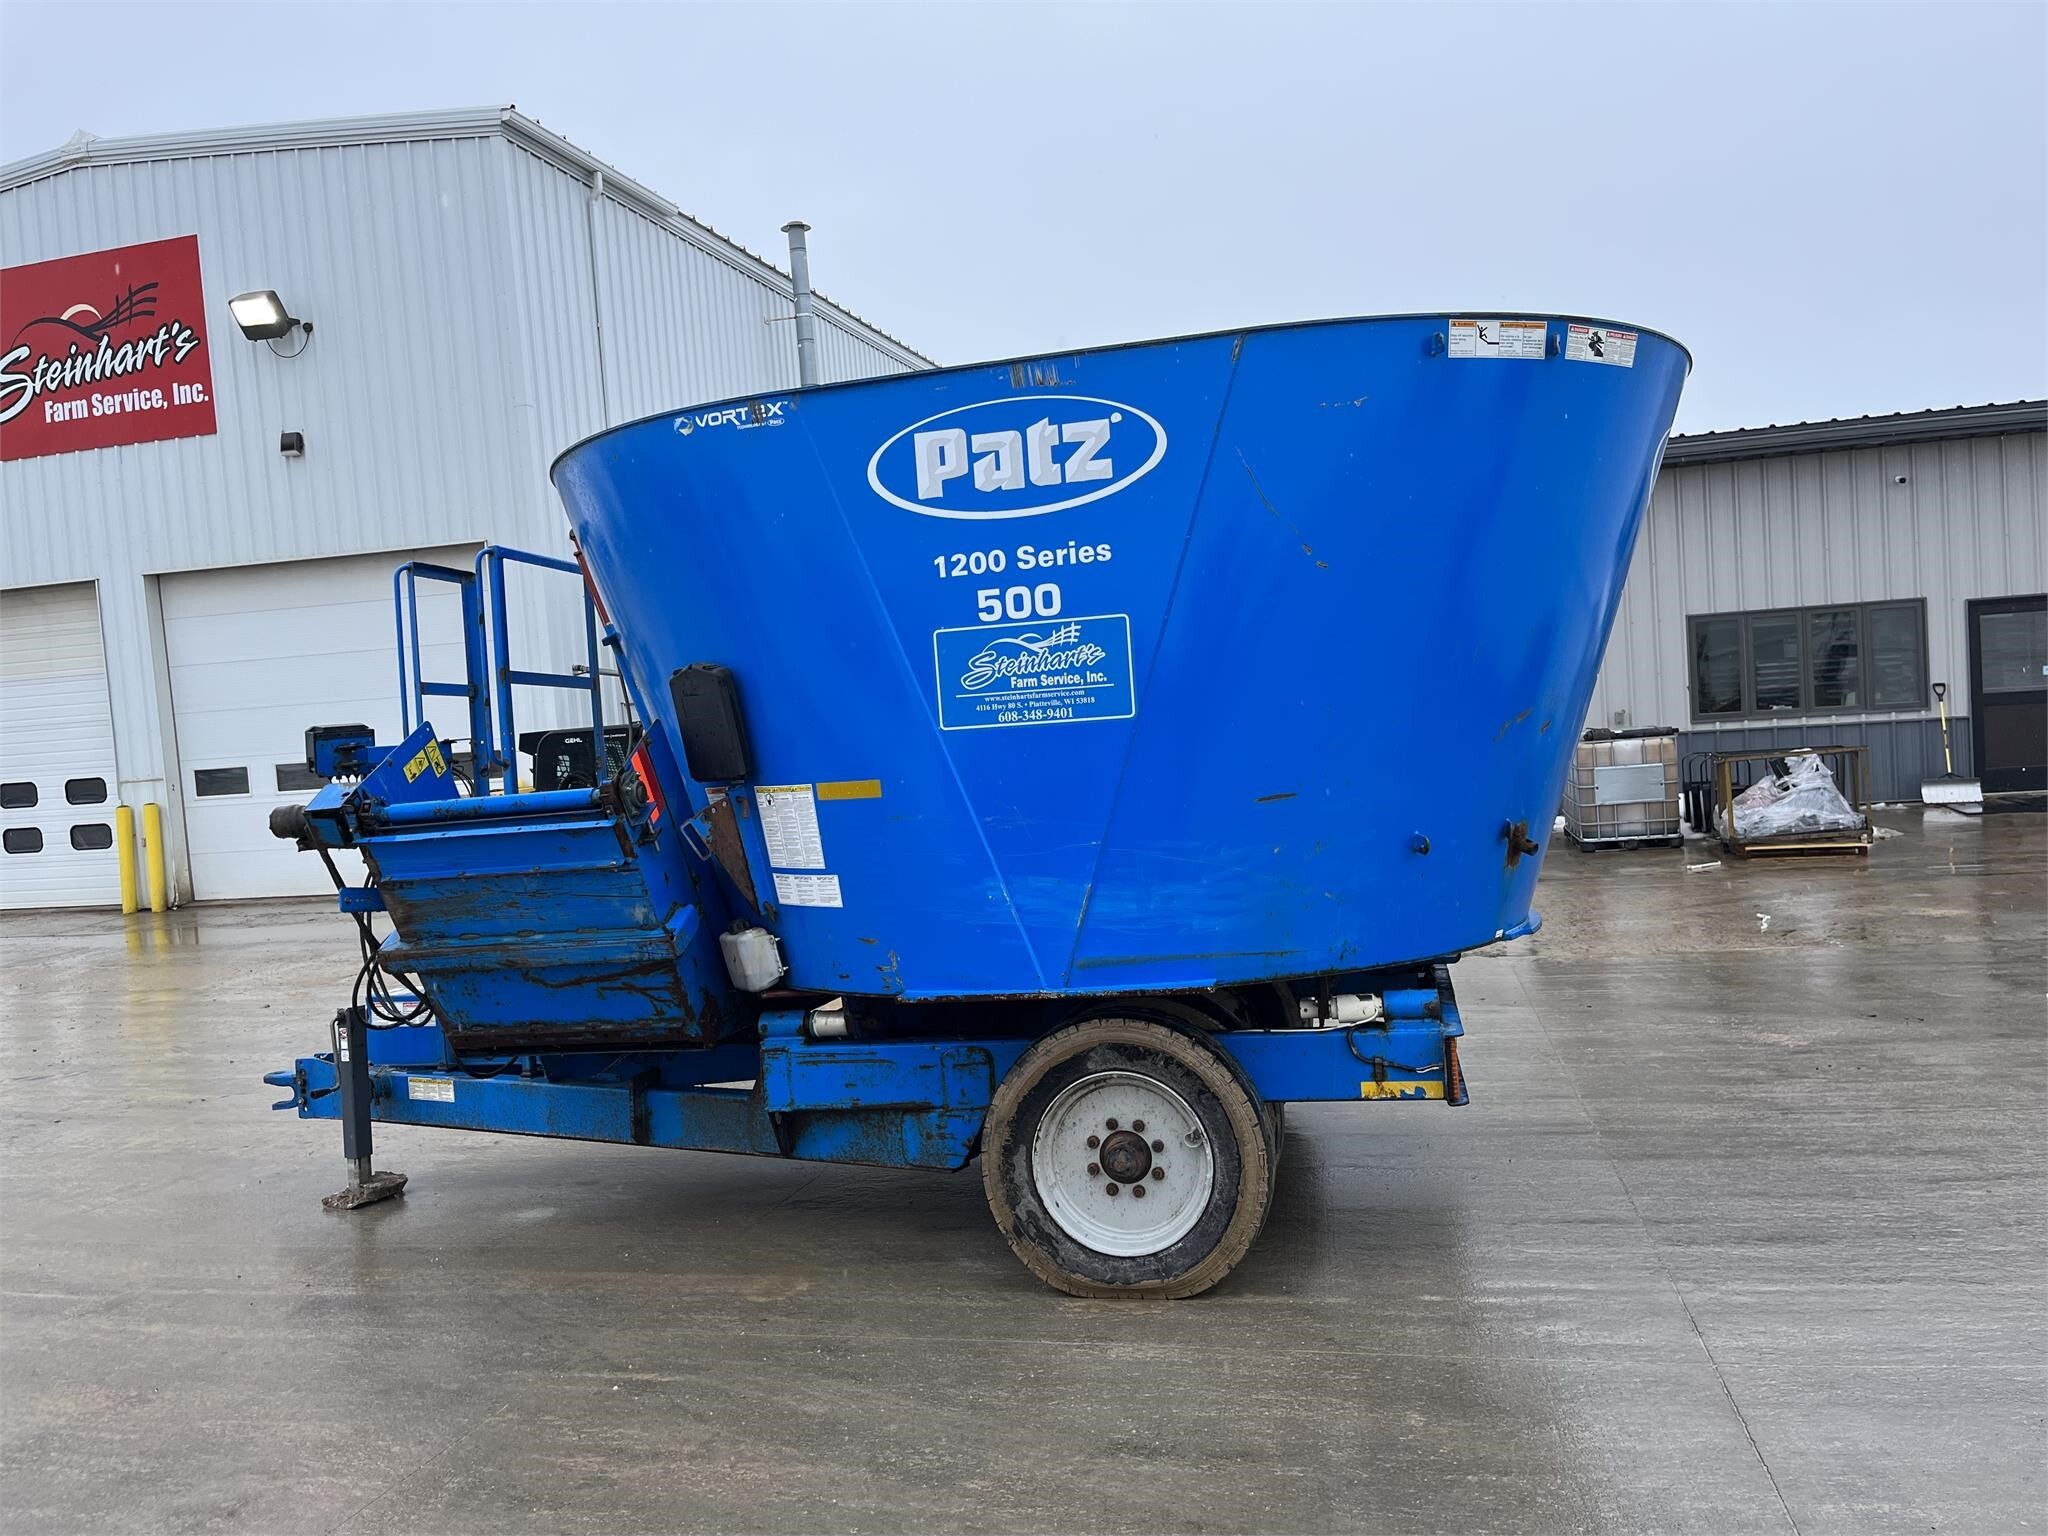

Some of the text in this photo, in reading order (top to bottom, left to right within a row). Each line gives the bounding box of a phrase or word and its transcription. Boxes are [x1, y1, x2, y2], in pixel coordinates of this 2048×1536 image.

[0, 321, 200, 424] Steinhart's
[44, 382, 209, 424] Farm Service, Inc.
[914, 416, 1113, 500] Patz
[933, 540, 1112, 578] 1200 Series
[977, 583, 1062, 622] 500
[961, 643, 1106, 690] Steinhart's
[1010, 671, 1108, 688] Farm Service, Inc.
[976, 703, 990, 711] 4116
[992, 702, 1007, 711] Hwy
[984, 690, 1085, 702] www.steinhartsfarmservice.com
[998, 707, 1073, 723] 608-348-9401
